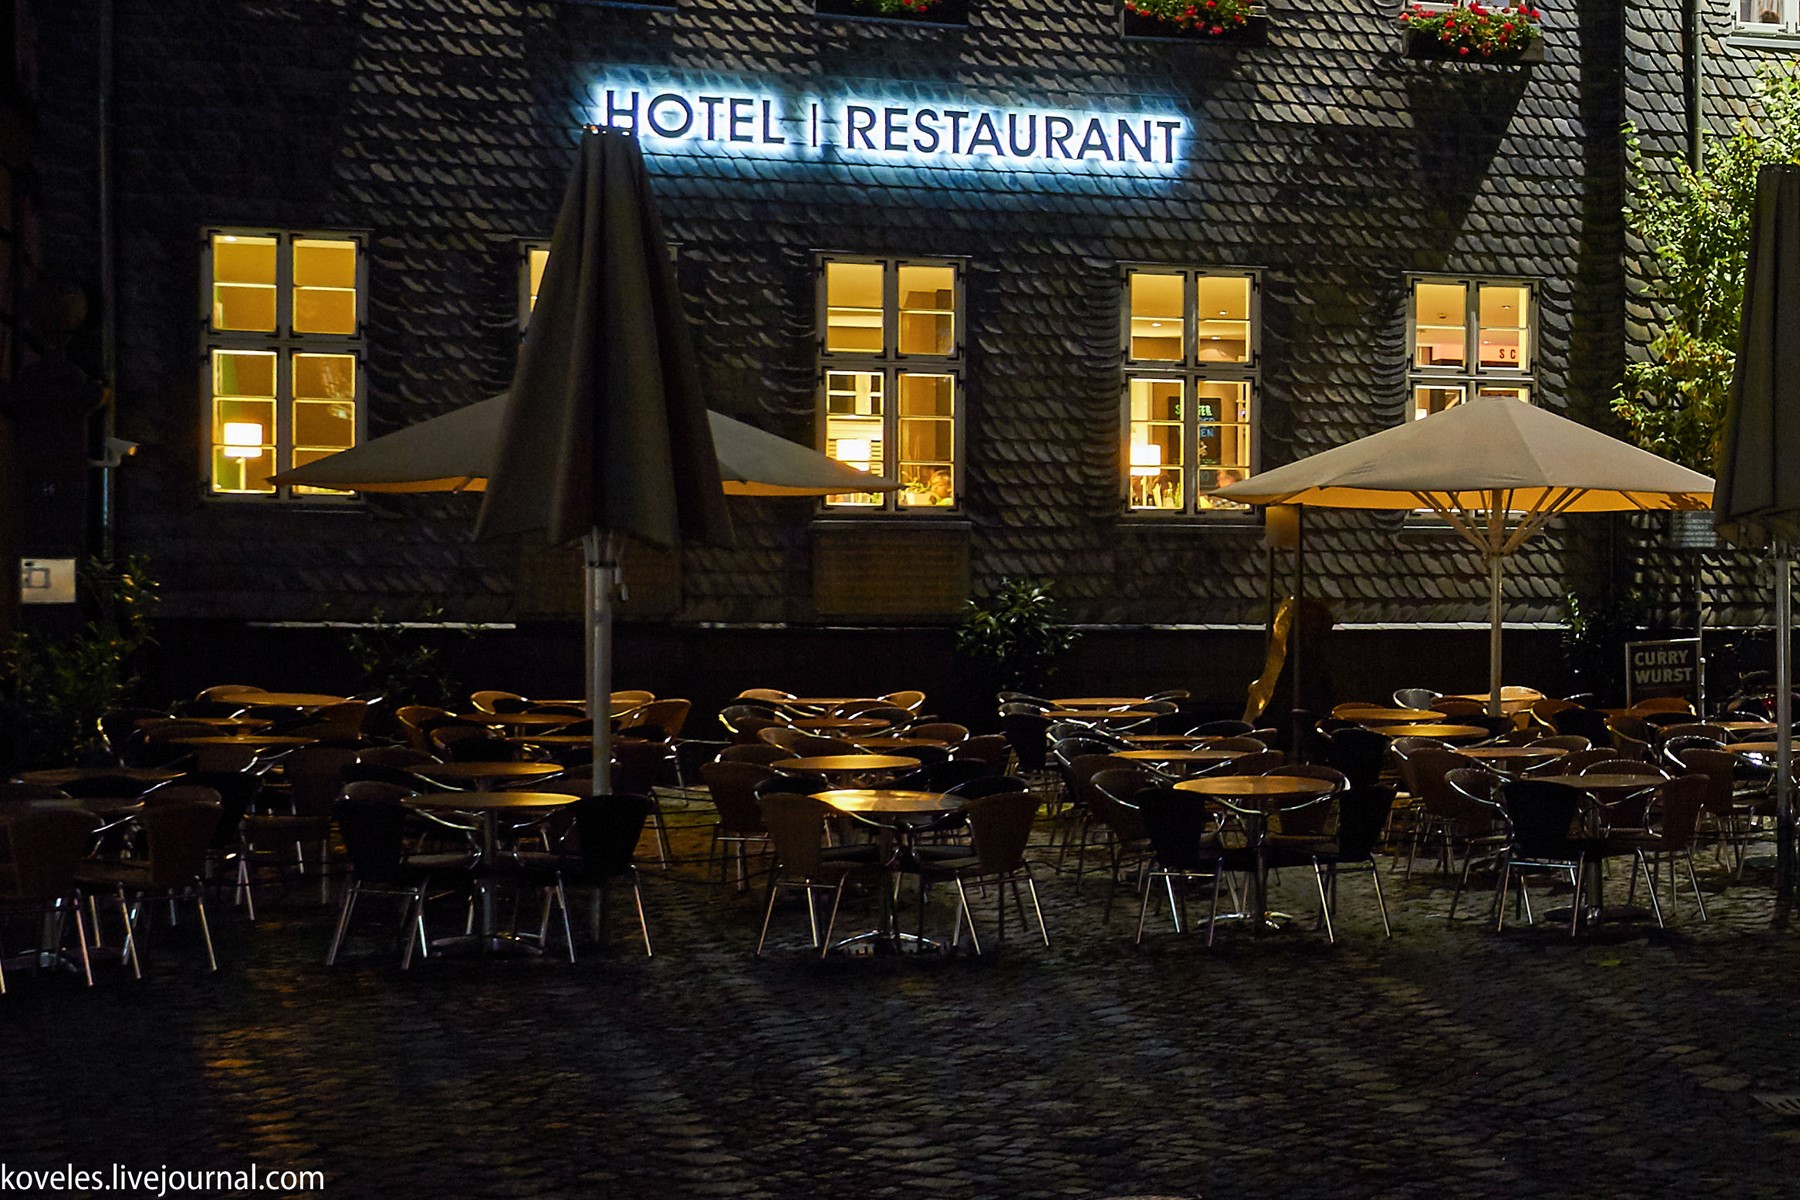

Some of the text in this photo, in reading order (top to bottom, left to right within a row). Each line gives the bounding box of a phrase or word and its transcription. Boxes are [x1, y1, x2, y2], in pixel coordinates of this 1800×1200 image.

[606, 90, 785, 145] HOTEL
[847, 105, 1182, 164] RESTAURANT
[1633, 650, 1689, 667] CURRY
[1634, 667, 1694, 685] WURST
